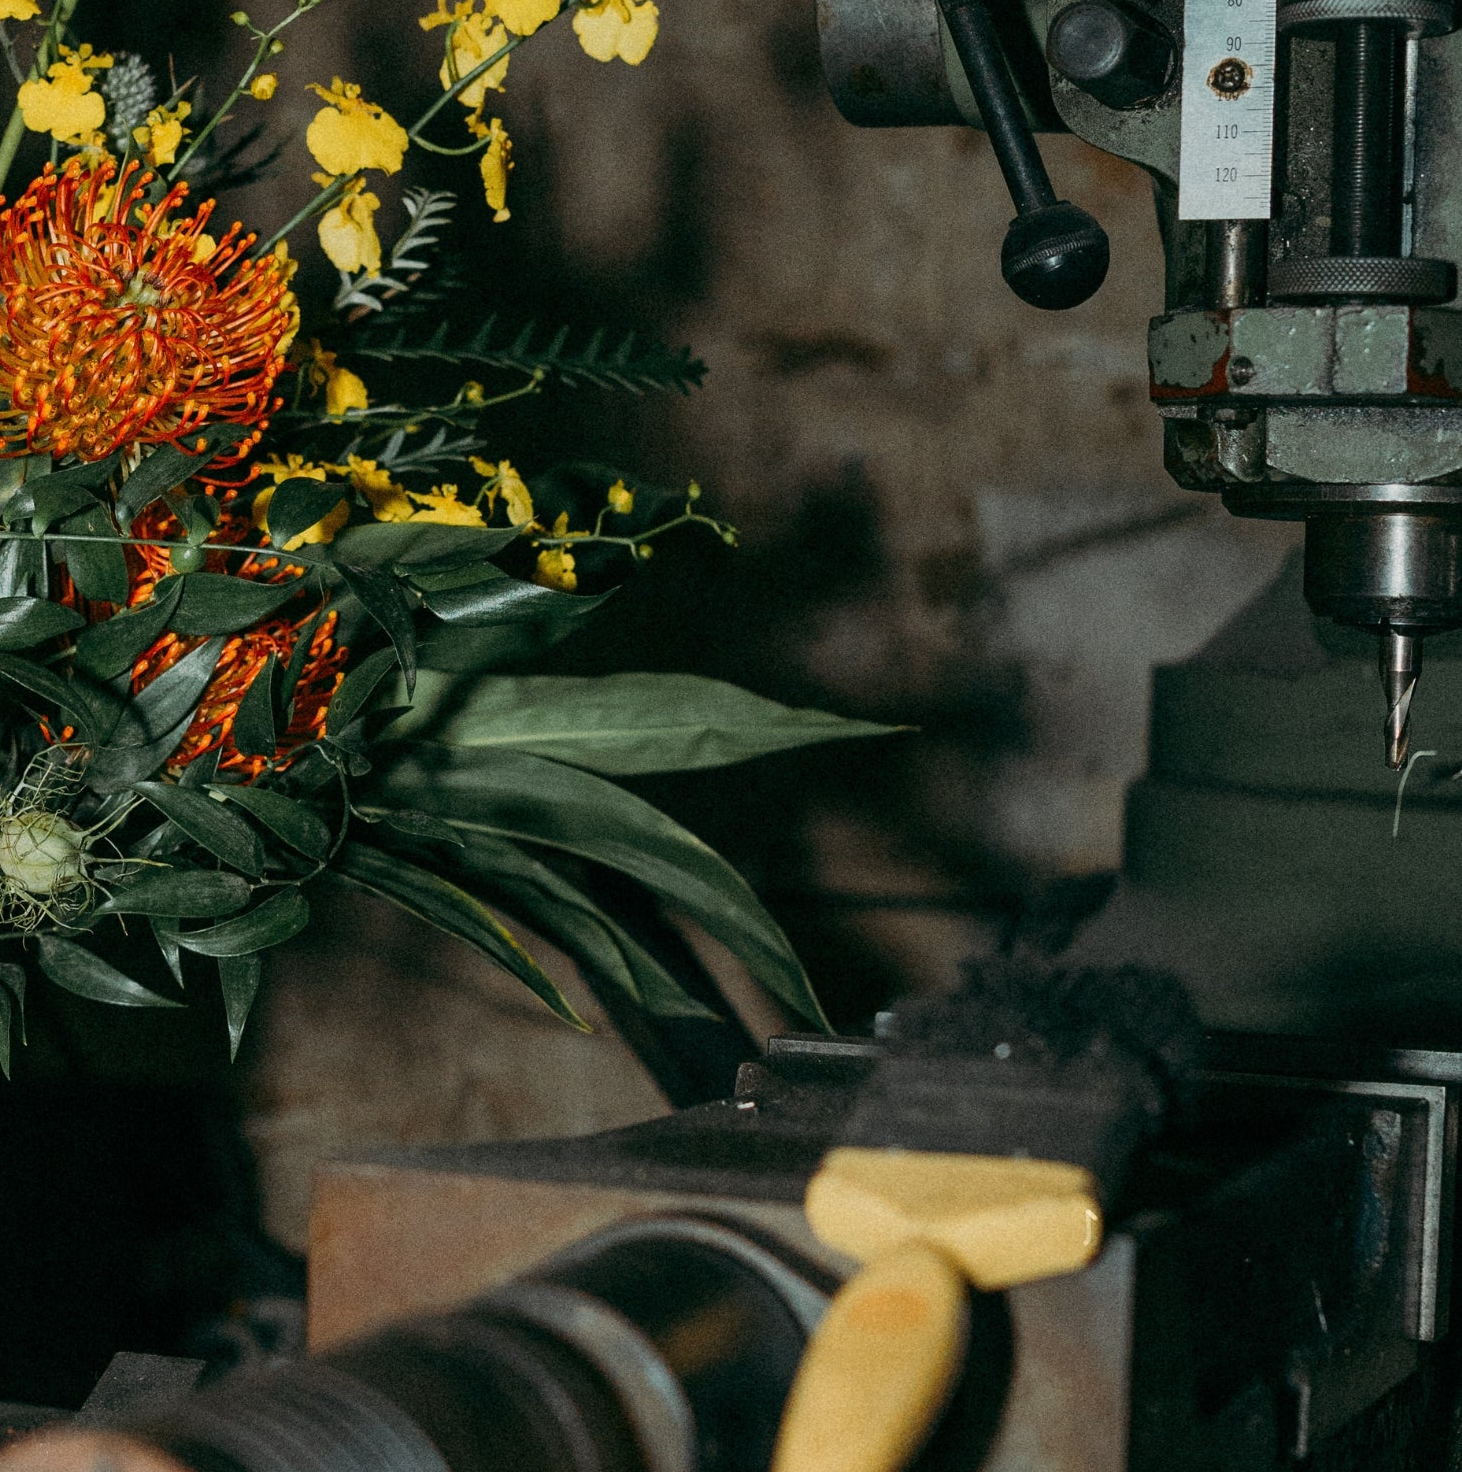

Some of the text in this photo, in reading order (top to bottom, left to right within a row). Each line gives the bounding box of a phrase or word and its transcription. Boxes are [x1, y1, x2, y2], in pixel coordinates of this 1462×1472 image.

[1226, 35, 1242, 51] 90
[1216, 124, 1238, 140] 110
[1215, 167, 1237, 183] 120
